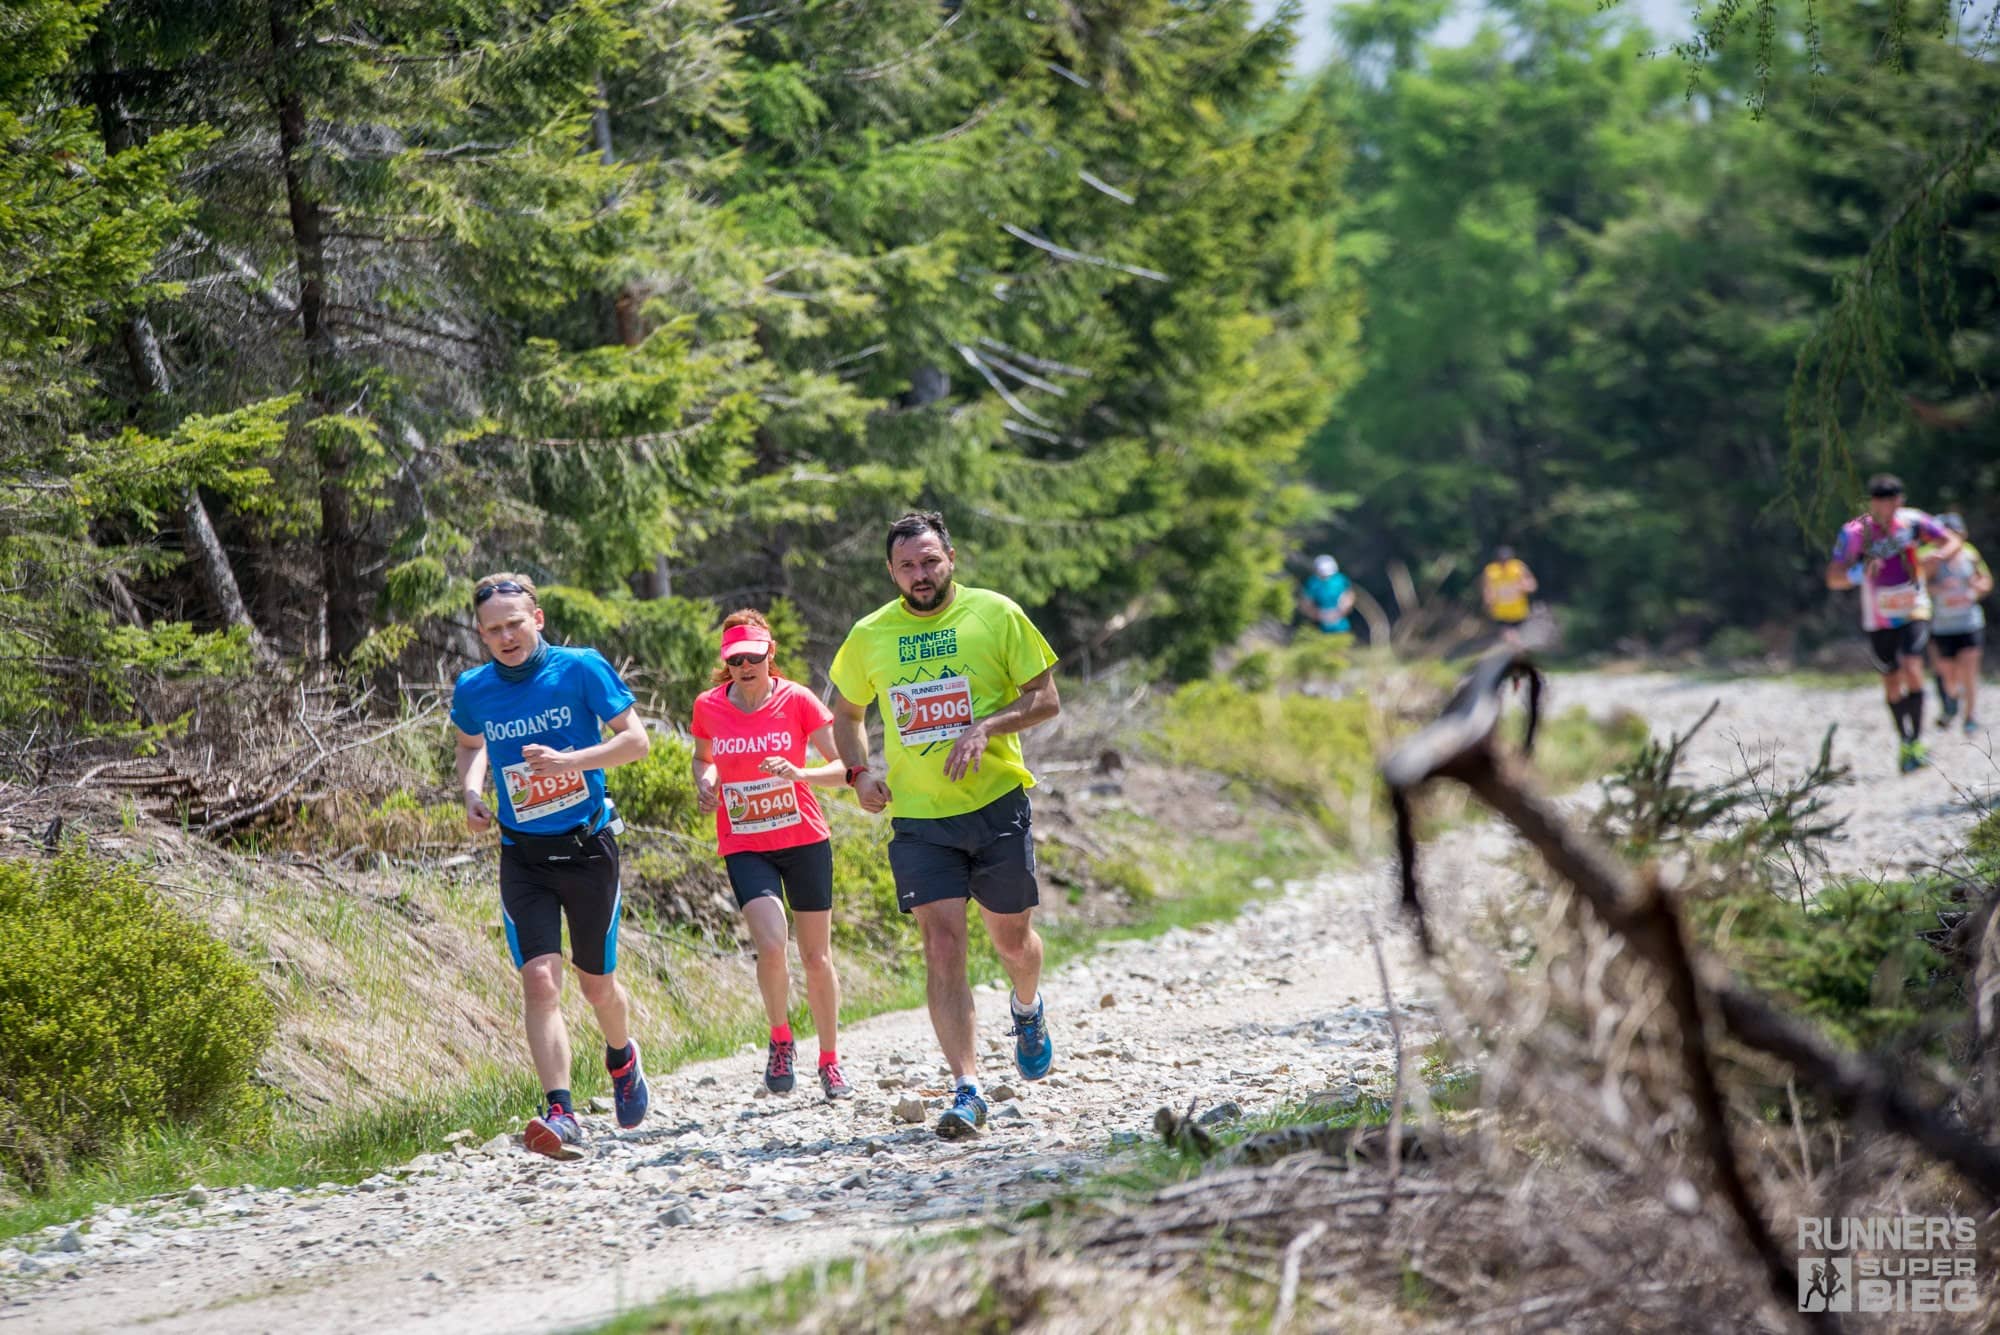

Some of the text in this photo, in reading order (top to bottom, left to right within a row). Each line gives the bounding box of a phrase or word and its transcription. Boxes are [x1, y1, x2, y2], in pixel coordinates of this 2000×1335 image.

[920, 637, 957, 649] SUPER
[920, 644, 957, 659] BIEG
[918, 698, 969, 723] 1906
[484, 705, 572, 742] BOGDAN'59
[712, 731, 792, 756] BOGDAN'59
[534, 770, 580, 798] 1939
[750, 792, 794, 815] 1940
